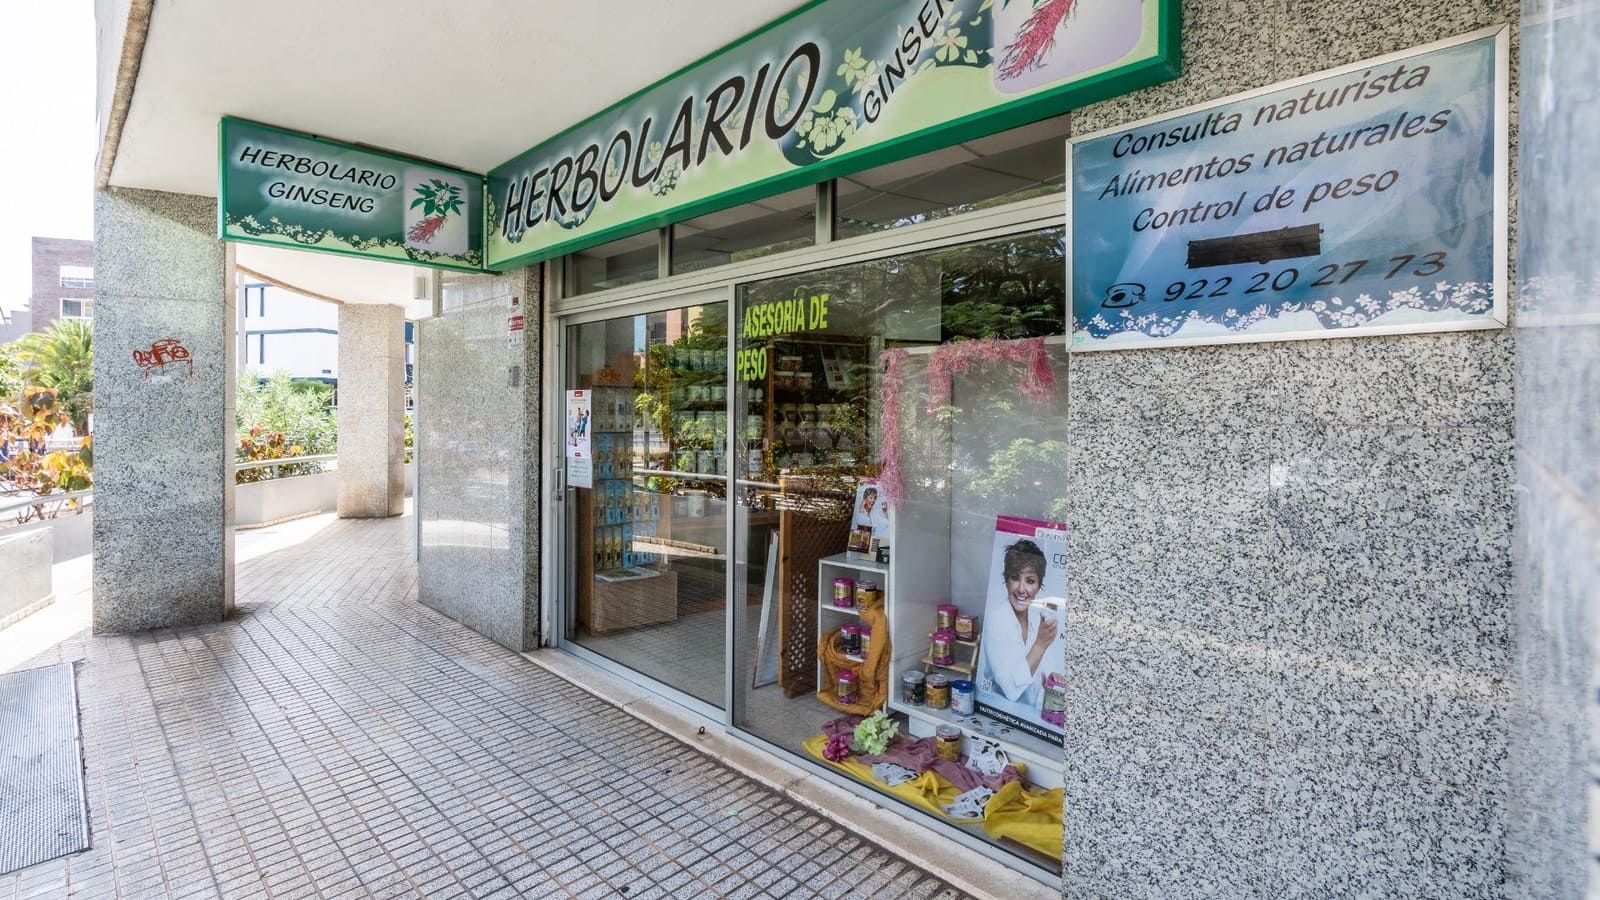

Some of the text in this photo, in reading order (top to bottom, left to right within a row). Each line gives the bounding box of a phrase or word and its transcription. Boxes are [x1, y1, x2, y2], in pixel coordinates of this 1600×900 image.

[1113, 64, 1431, 159] Consulta naturista
[502, 42, 822, 238] HERBOLARIO
[1098, 107, 1453, 201] Alimentos naturales
[239, 146, 397, 190] HERBOLARIO
[267, 181, 375, 214] GINSENG
[1132, 169, 1400, 233] Control de peso
[1163, 251, 1448, 303] 922 20 27 73
[742, 288, 830, 338] ASESORÍA DE
[736, 346, 768, 381] PESO
[1020, 722, 1048, 739] AVANZADA
[1047, 733, 1063, 745] PARA
